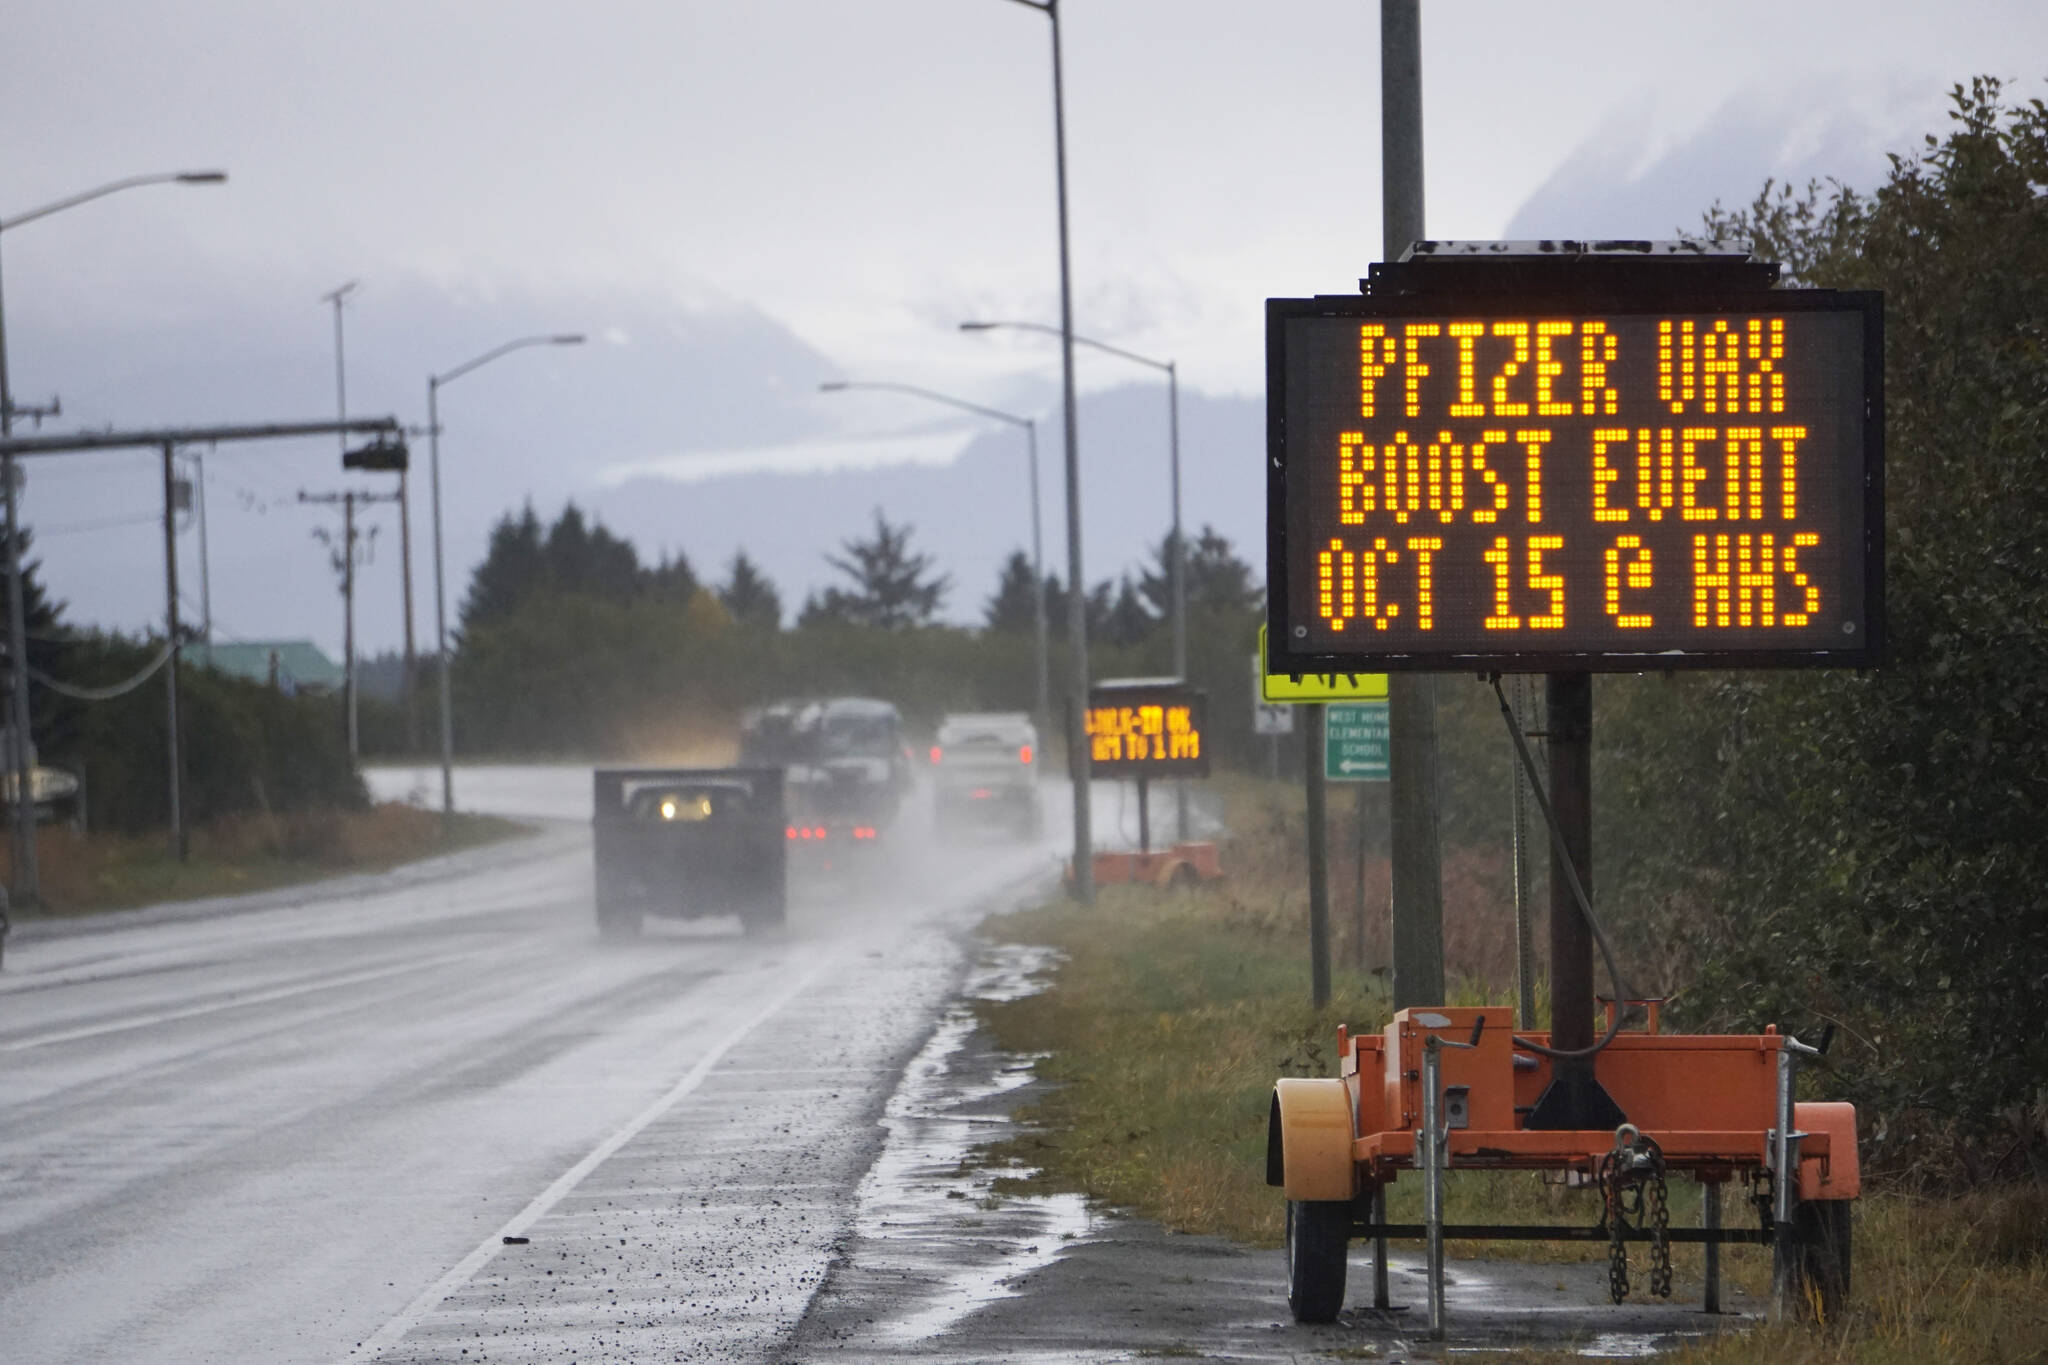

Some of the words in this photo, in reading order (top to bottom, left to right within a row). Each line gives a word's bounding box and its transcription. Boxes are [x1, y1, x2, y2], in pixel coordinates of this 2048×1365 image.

[1360, 321, 1618, 418] PFIZER
[1658, 318, 1785, 414] VAX
[1339, 428, 1553, 525] BOOST
[1592, 425, 1807, 522] EVENT
[1318, 536, 1443, 631] OCT
[1483, 535, 1566, 629] 15
[1604, 534, 1654, 628] @
[1692, 532, 1820, 627] HHS
